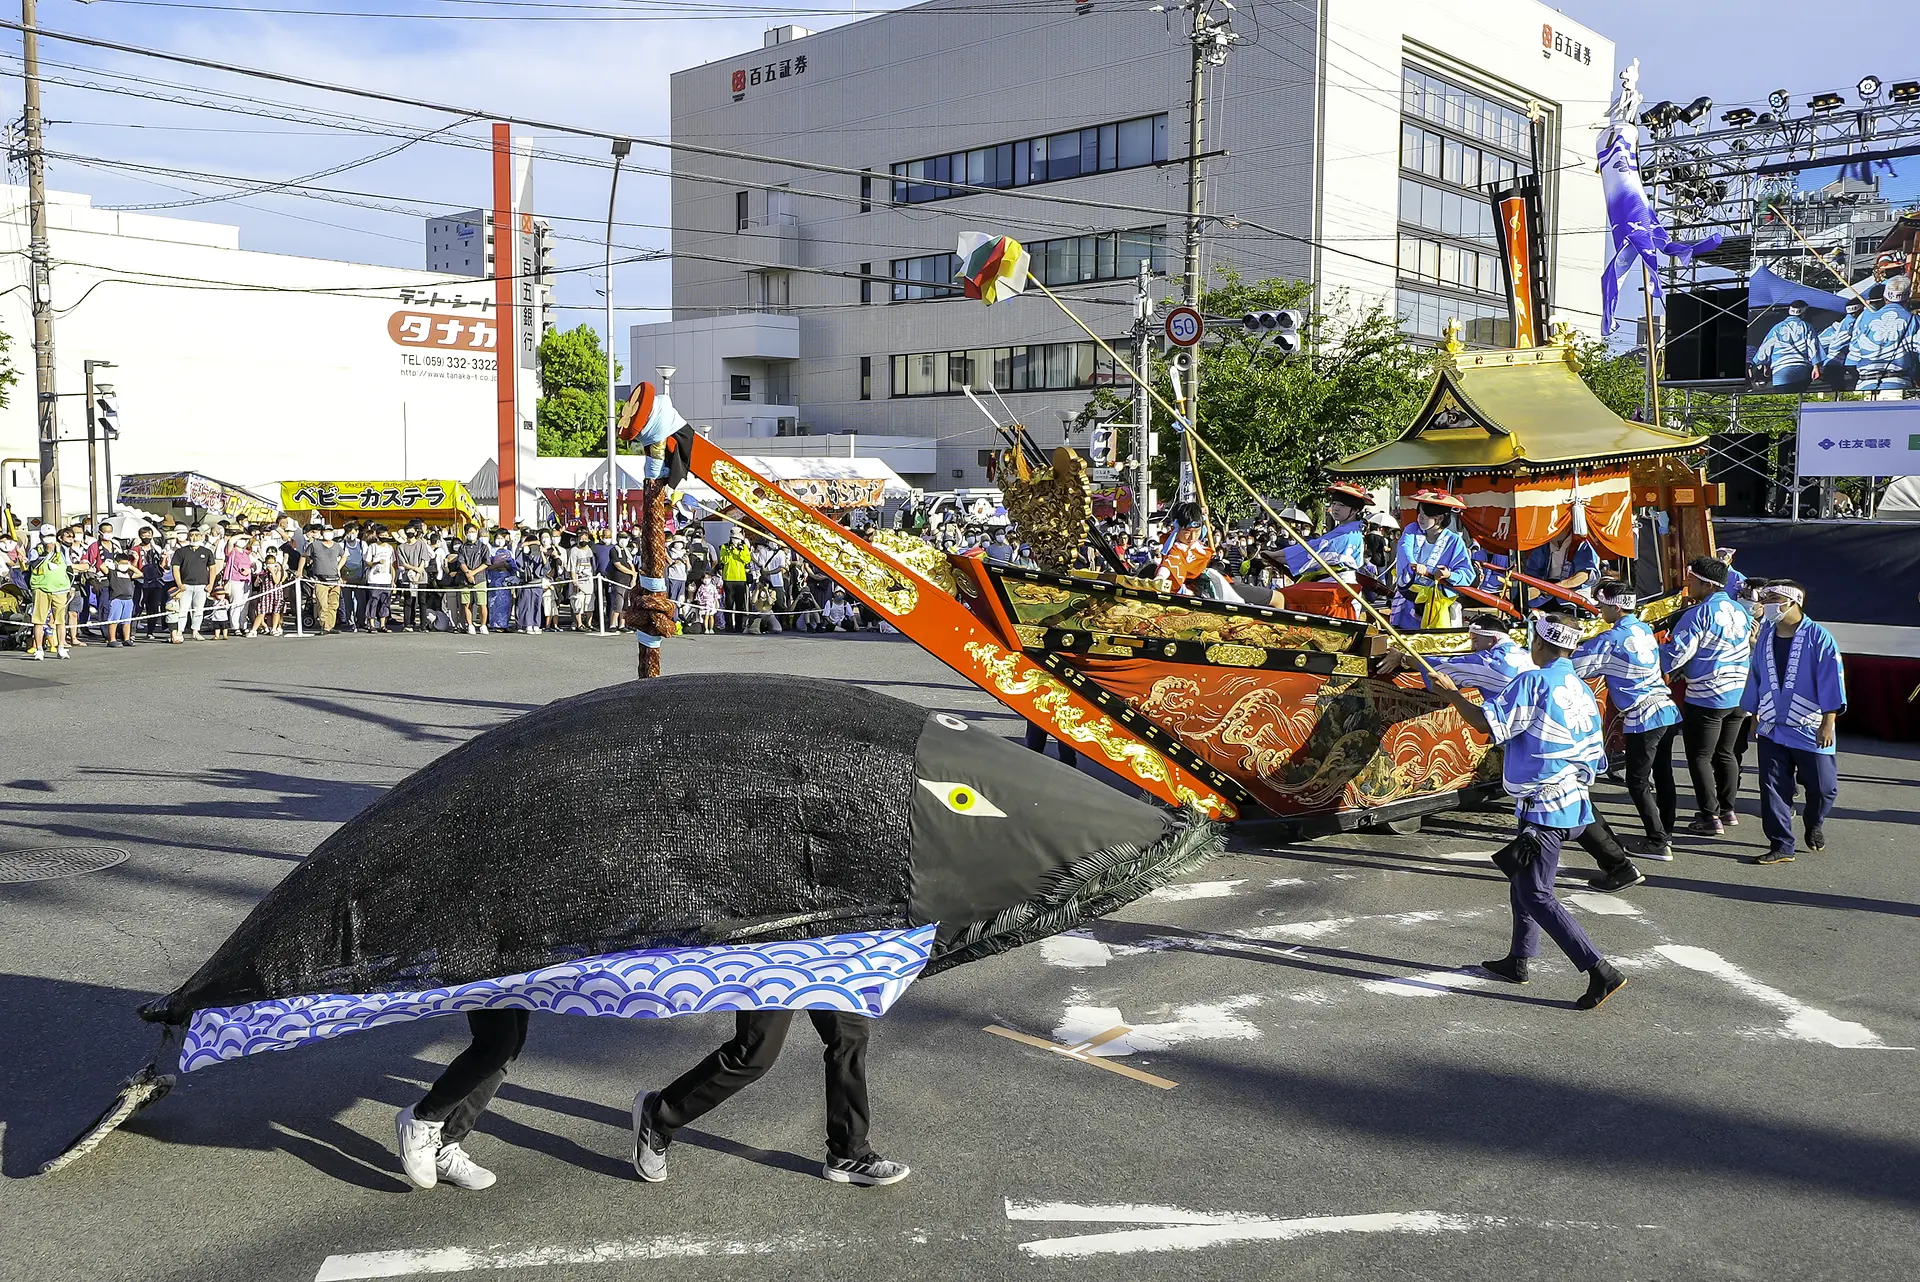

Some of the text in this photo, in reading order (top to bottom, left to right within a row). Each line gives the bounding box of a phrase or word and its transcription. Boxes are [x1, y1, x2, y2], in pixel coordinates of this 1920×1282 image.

[1554, 31, 1591, 66] 百五証券
[749, 55, 808, 86] 百五証券
[522, 257, 533, 352] 百五銀行
[400, 315, 498, 348] タナカ
[1173, 318, 1195, 336] 50
[446, 356, 498, 370] 332-3322
[1838, 439, 1892, 449] 住友電装
[295, 486, 446, 508] ベビーカステラ
